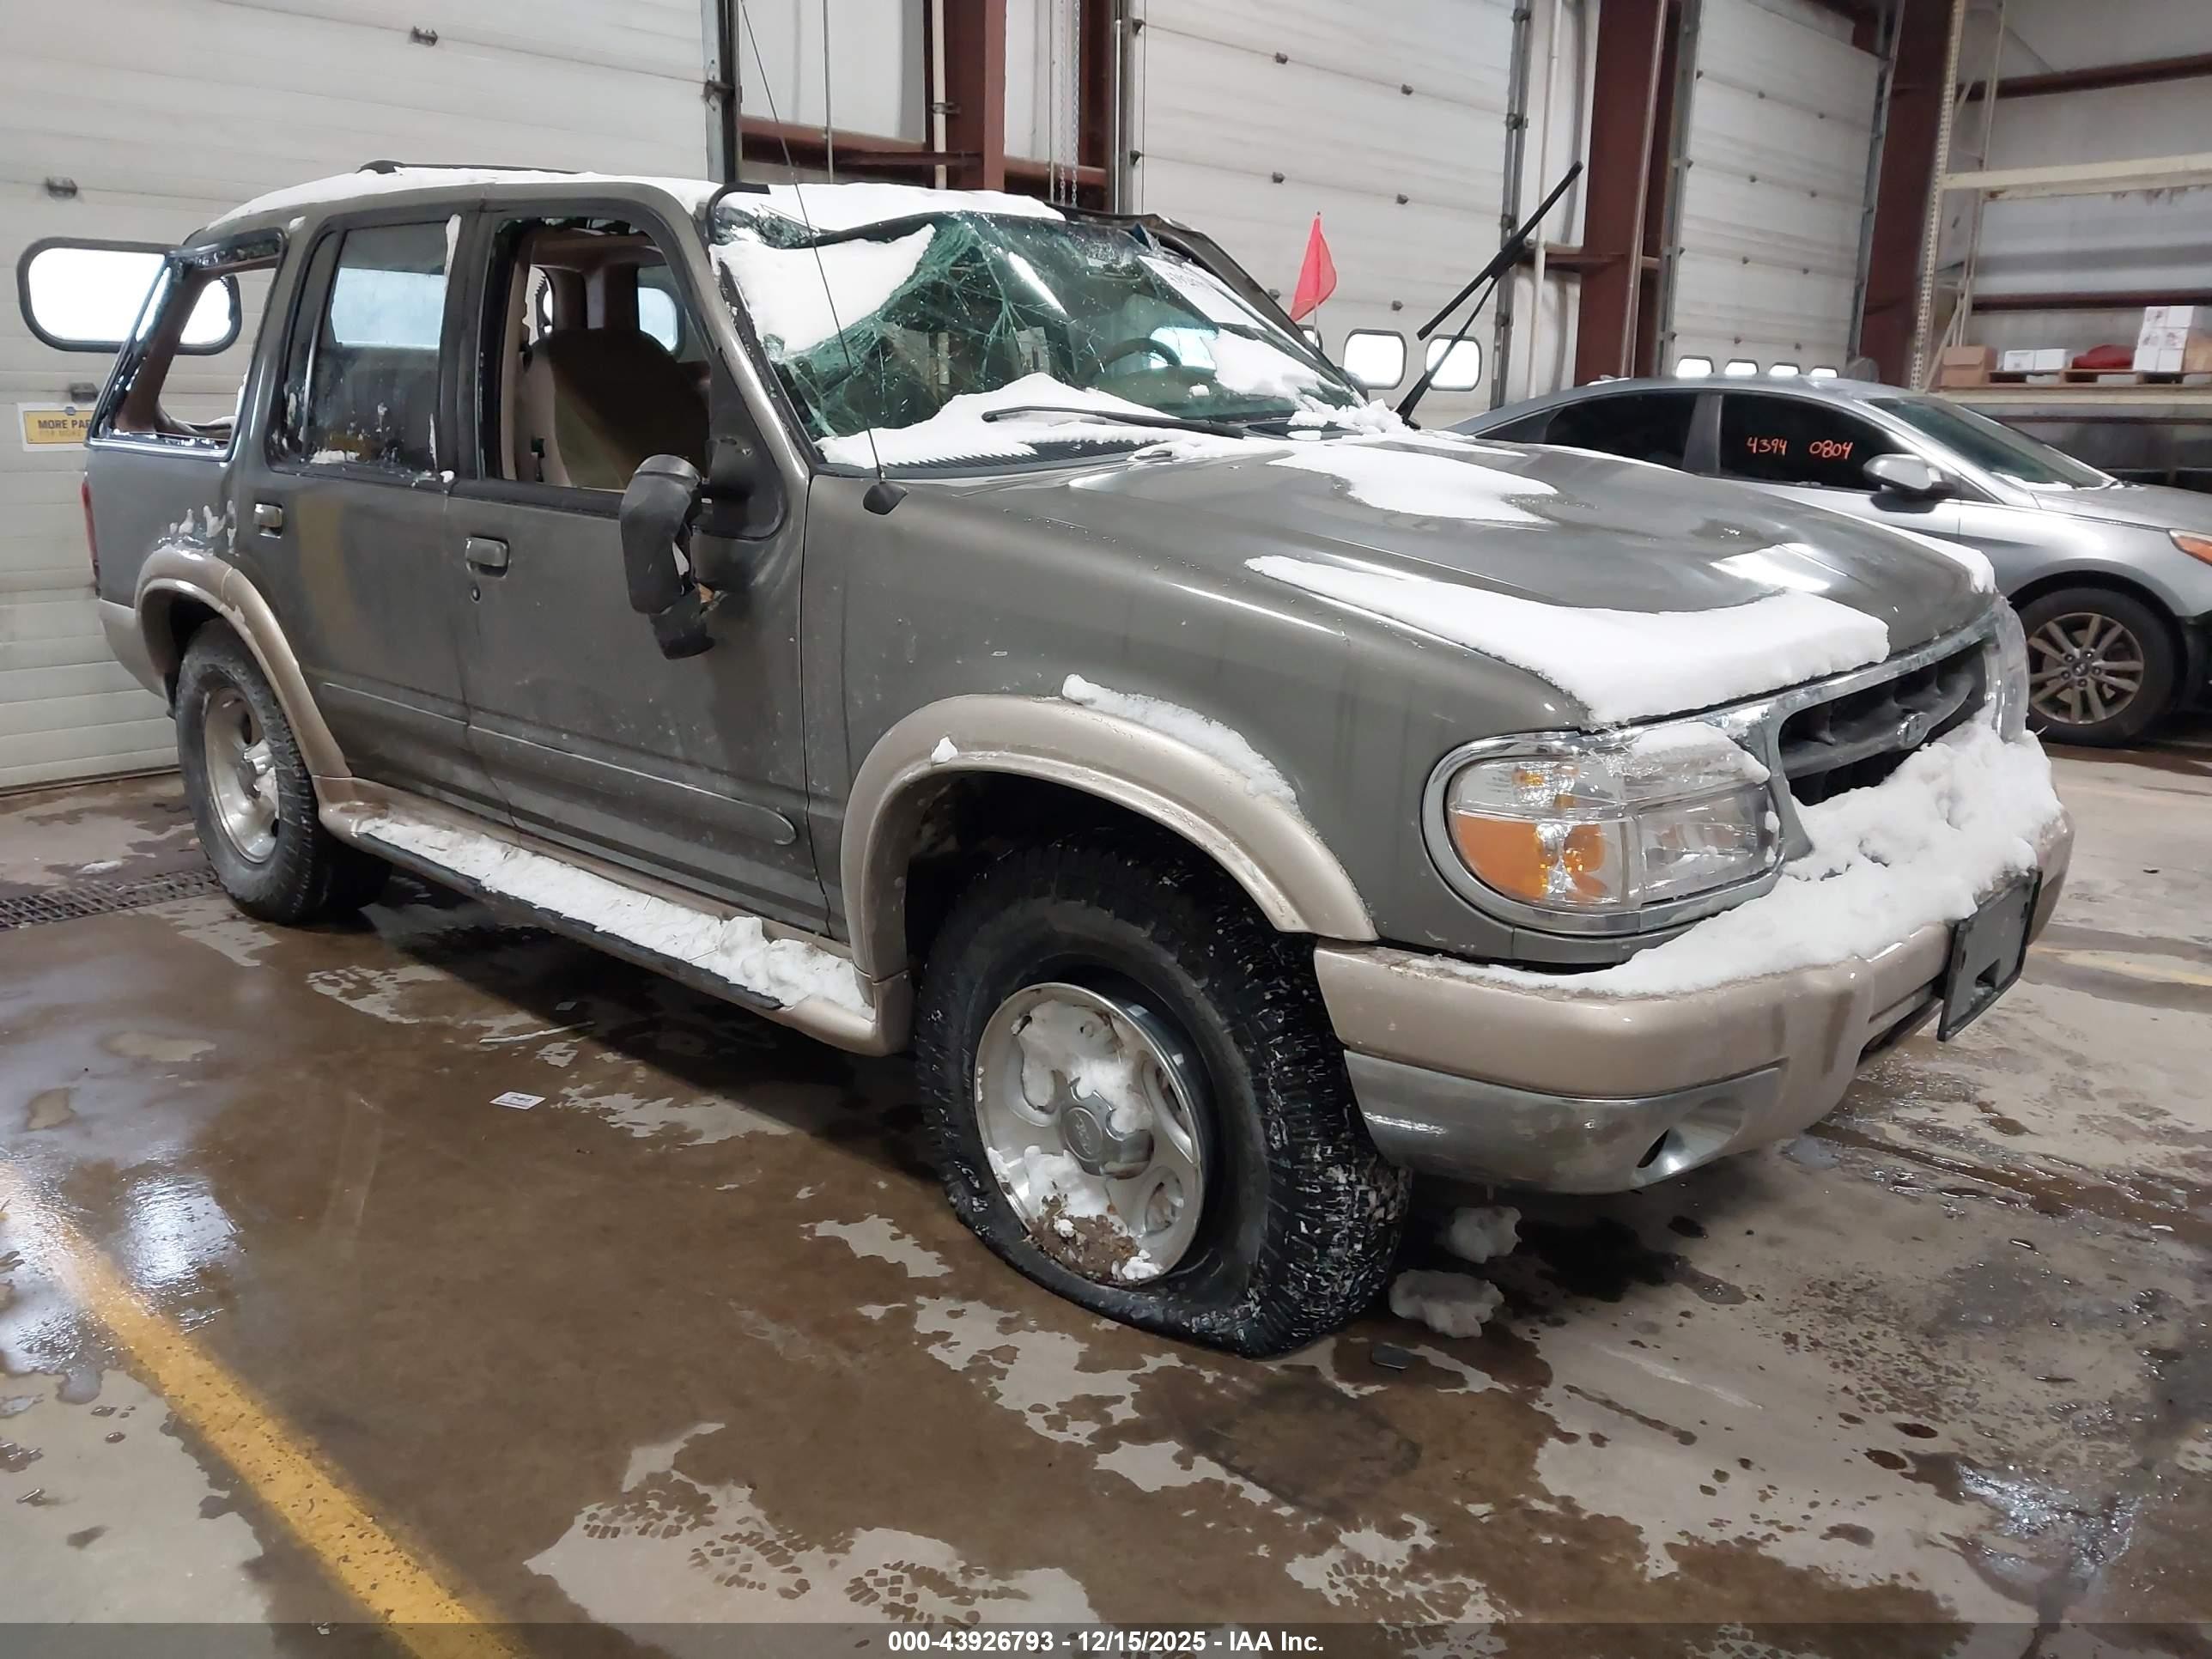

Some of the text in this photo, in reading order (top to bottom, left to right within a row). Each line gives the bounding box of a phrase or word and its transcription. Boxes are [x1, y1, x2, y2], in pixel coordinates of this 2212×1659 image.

[38, 419, 69, 429] MORE
[1746, 436, 1853, 460] 4394 0804
